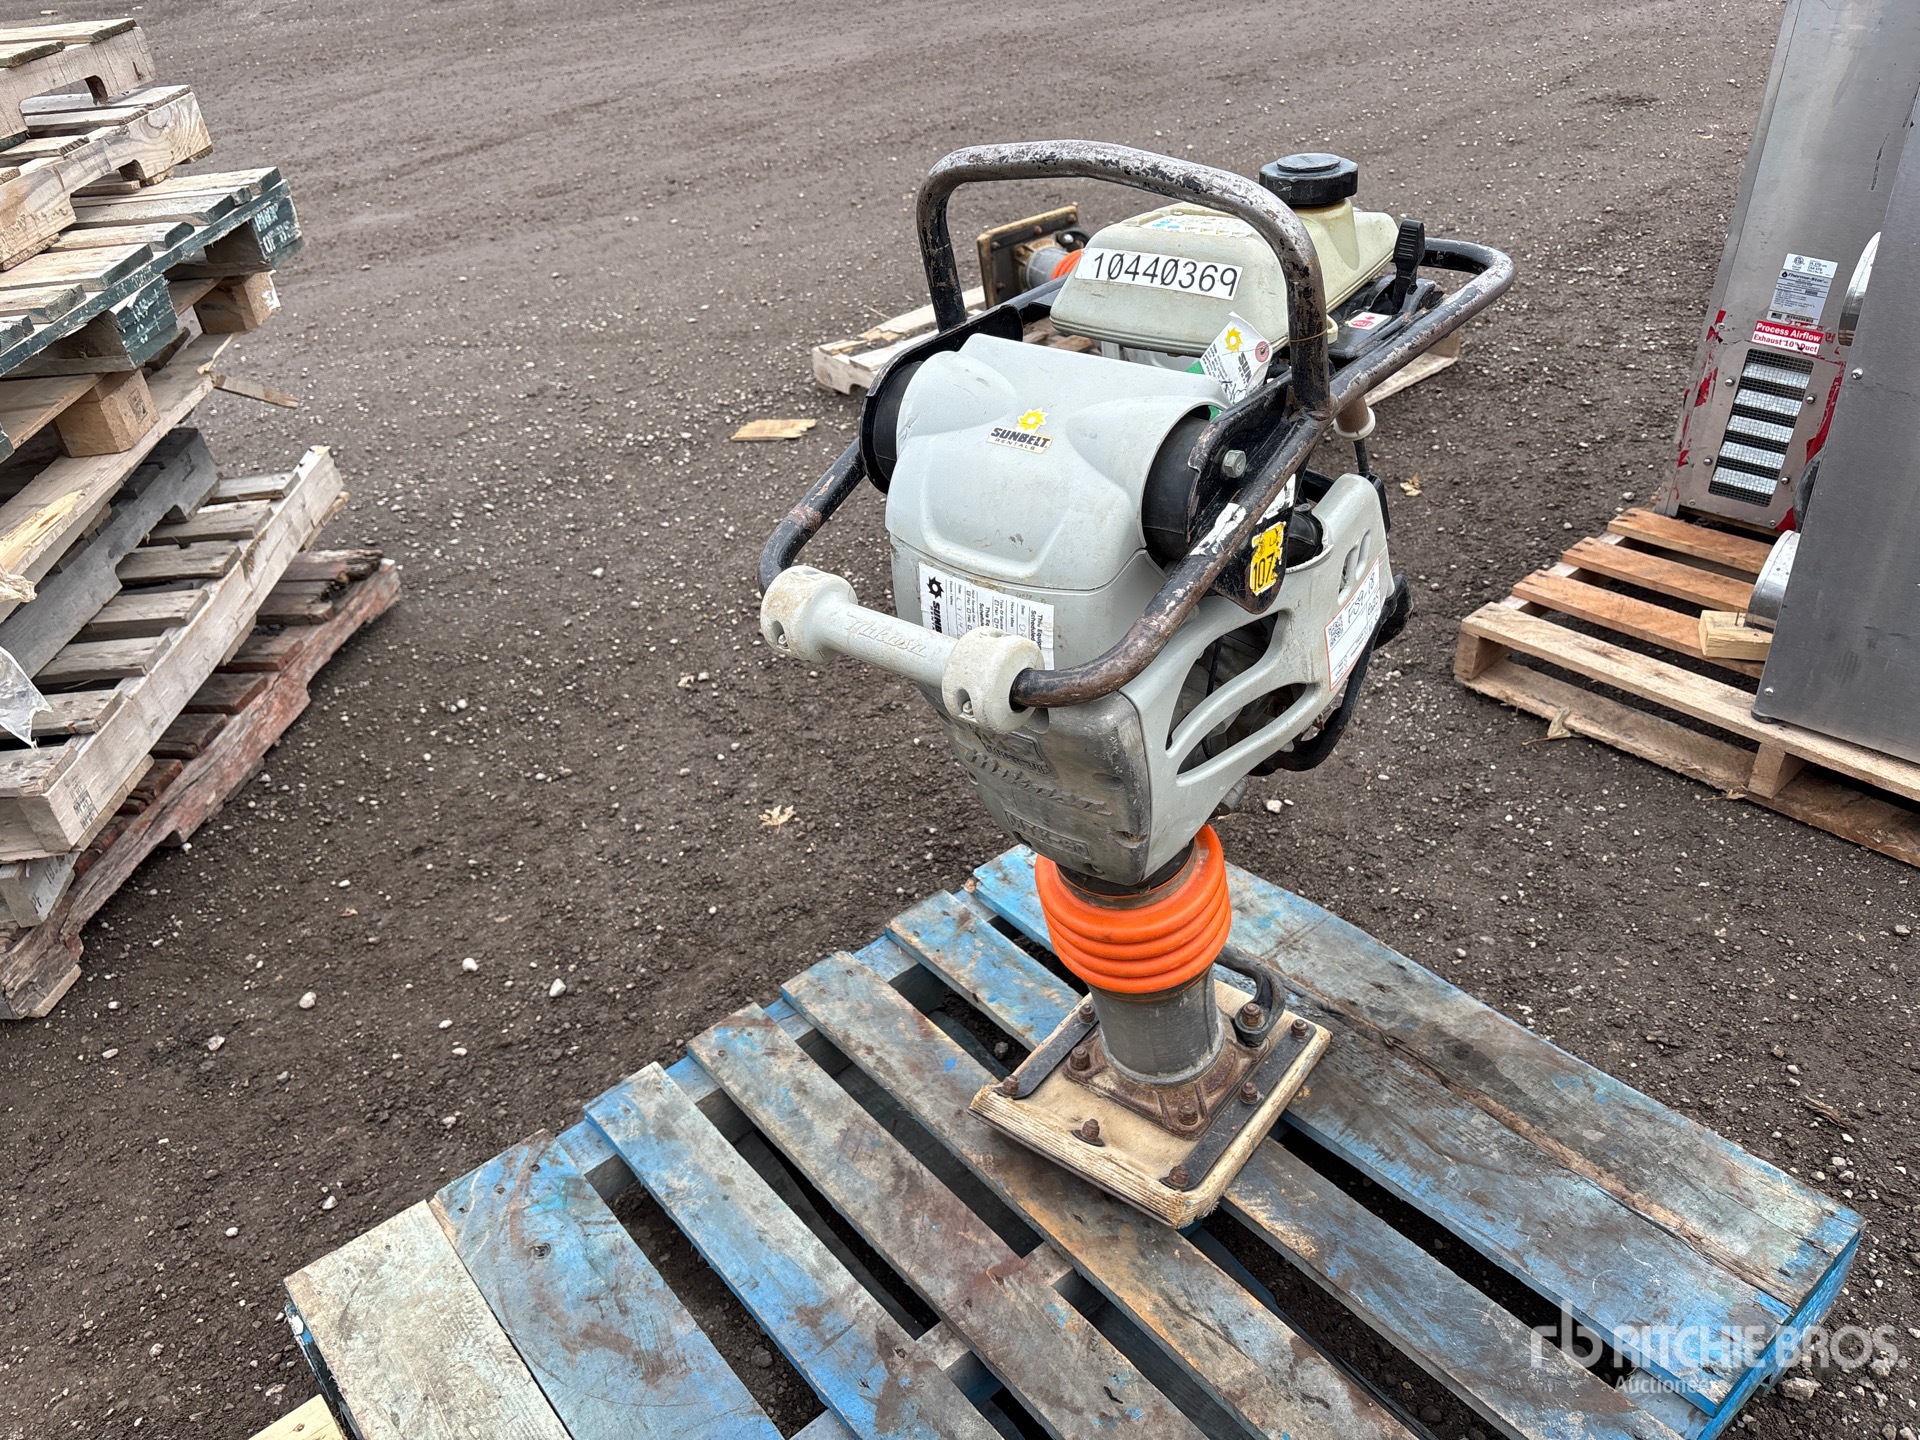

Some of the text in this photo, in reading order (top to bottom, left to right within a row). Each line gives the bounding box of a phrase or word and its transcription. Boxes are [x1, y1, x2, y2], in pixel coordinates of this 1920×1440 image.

[1093, 252, 1238, 297] 10440369
[1756, 323, 1821, 343] Process Airflow
[1753, 334, 1782, 346] Exhaust
[1798, 343, 1818, 353] Duct
[991, 427, 1051, 448] SUNBELT
[994, 439, 1036, 451] RENTALS
